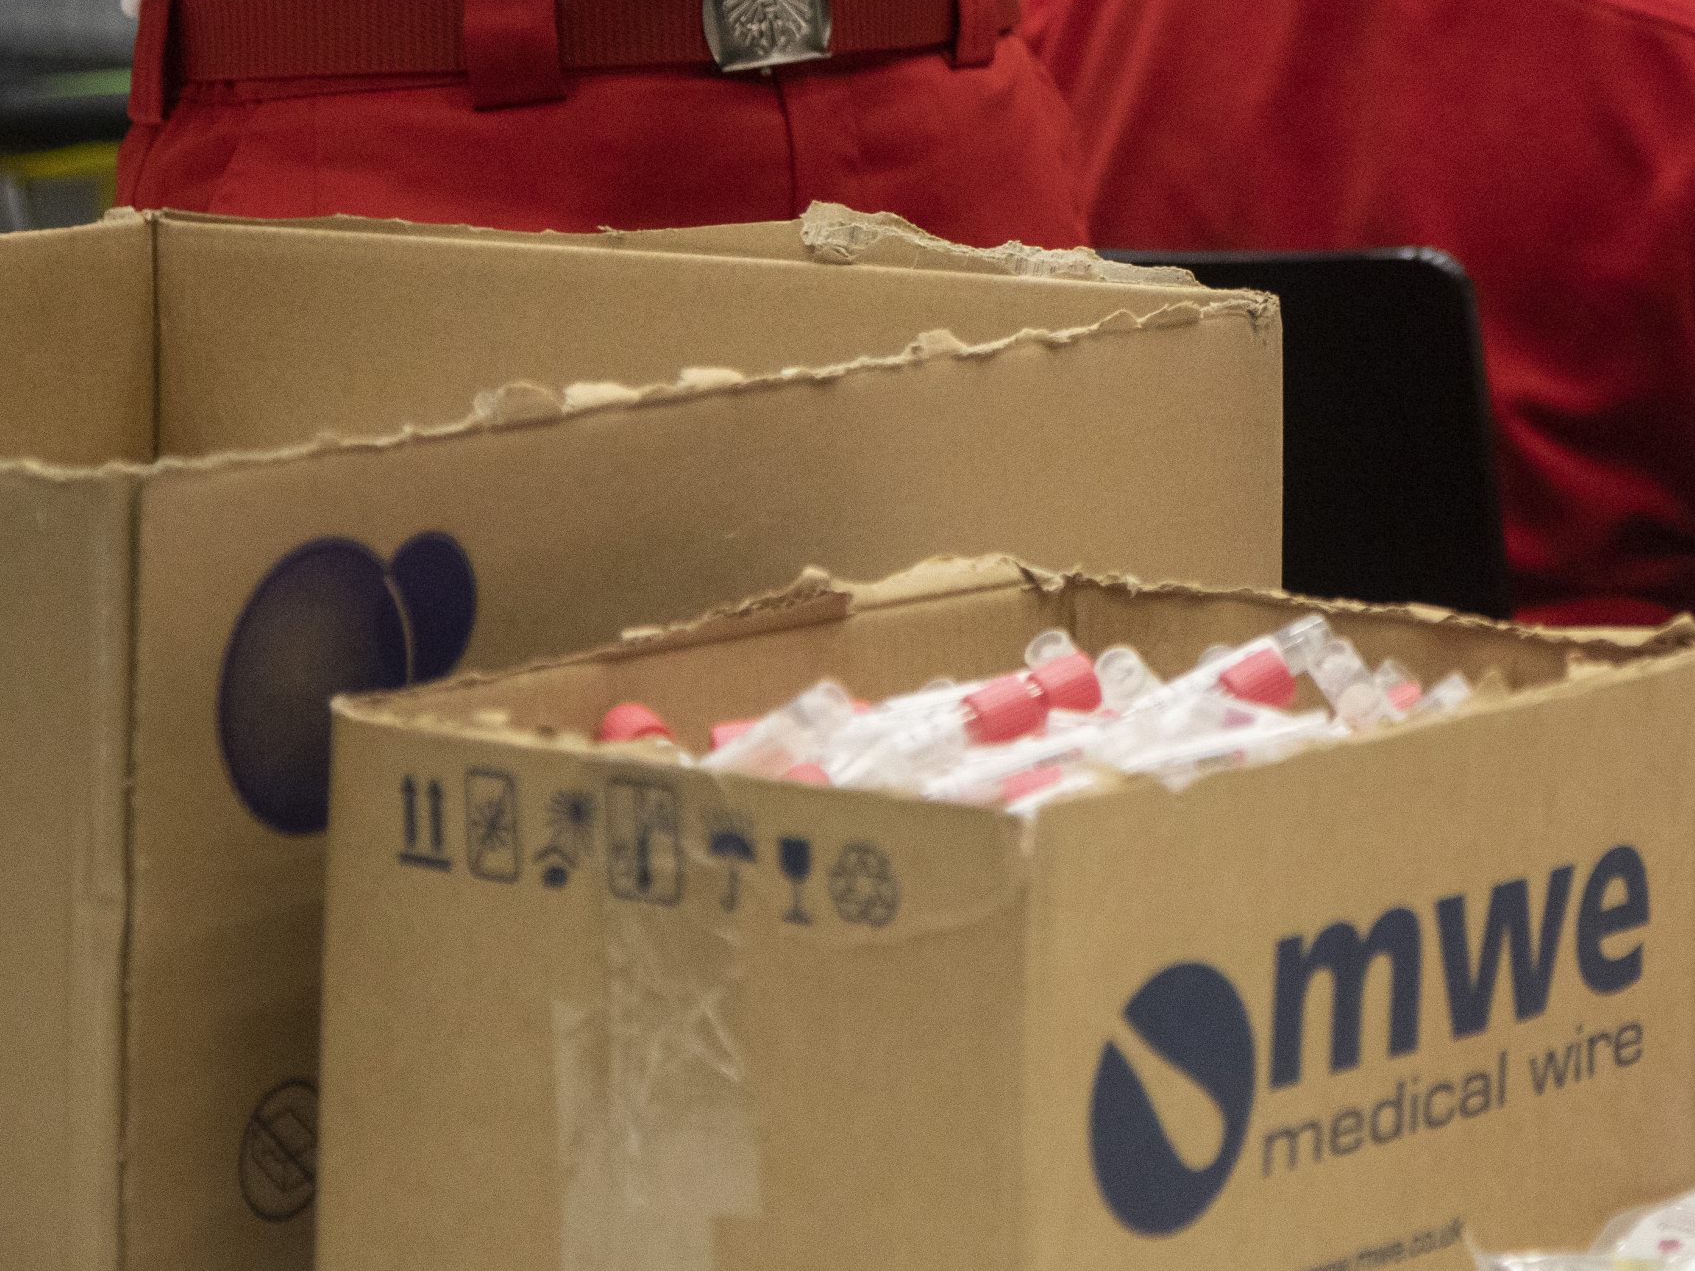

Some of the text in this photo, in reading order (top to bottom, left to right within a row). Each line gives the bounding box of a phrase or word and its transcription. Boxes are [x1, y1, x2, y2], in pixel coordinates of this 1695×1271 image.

[1268, 843, 1652, 1092] mwe
[1261, 1020, 1645, 1179] medical wire
